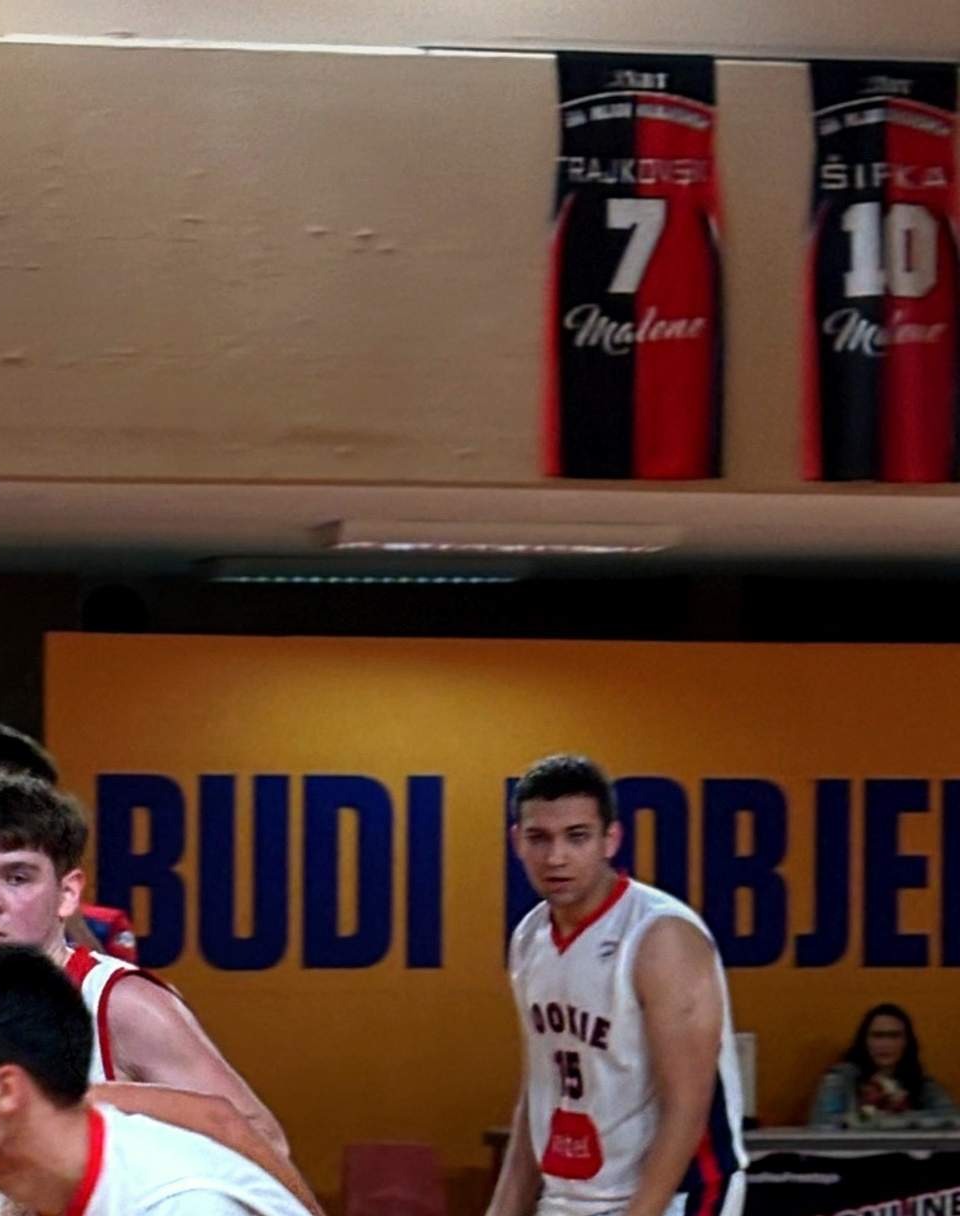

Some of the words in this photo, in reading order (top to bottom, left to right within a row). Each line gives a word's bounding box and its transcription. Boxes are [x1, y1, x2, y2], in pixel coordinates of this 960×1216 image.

[606, 198, 667, 294] 7
[842, 202, 937, 298] 10
[96, 773, 444, 971] BUDI
